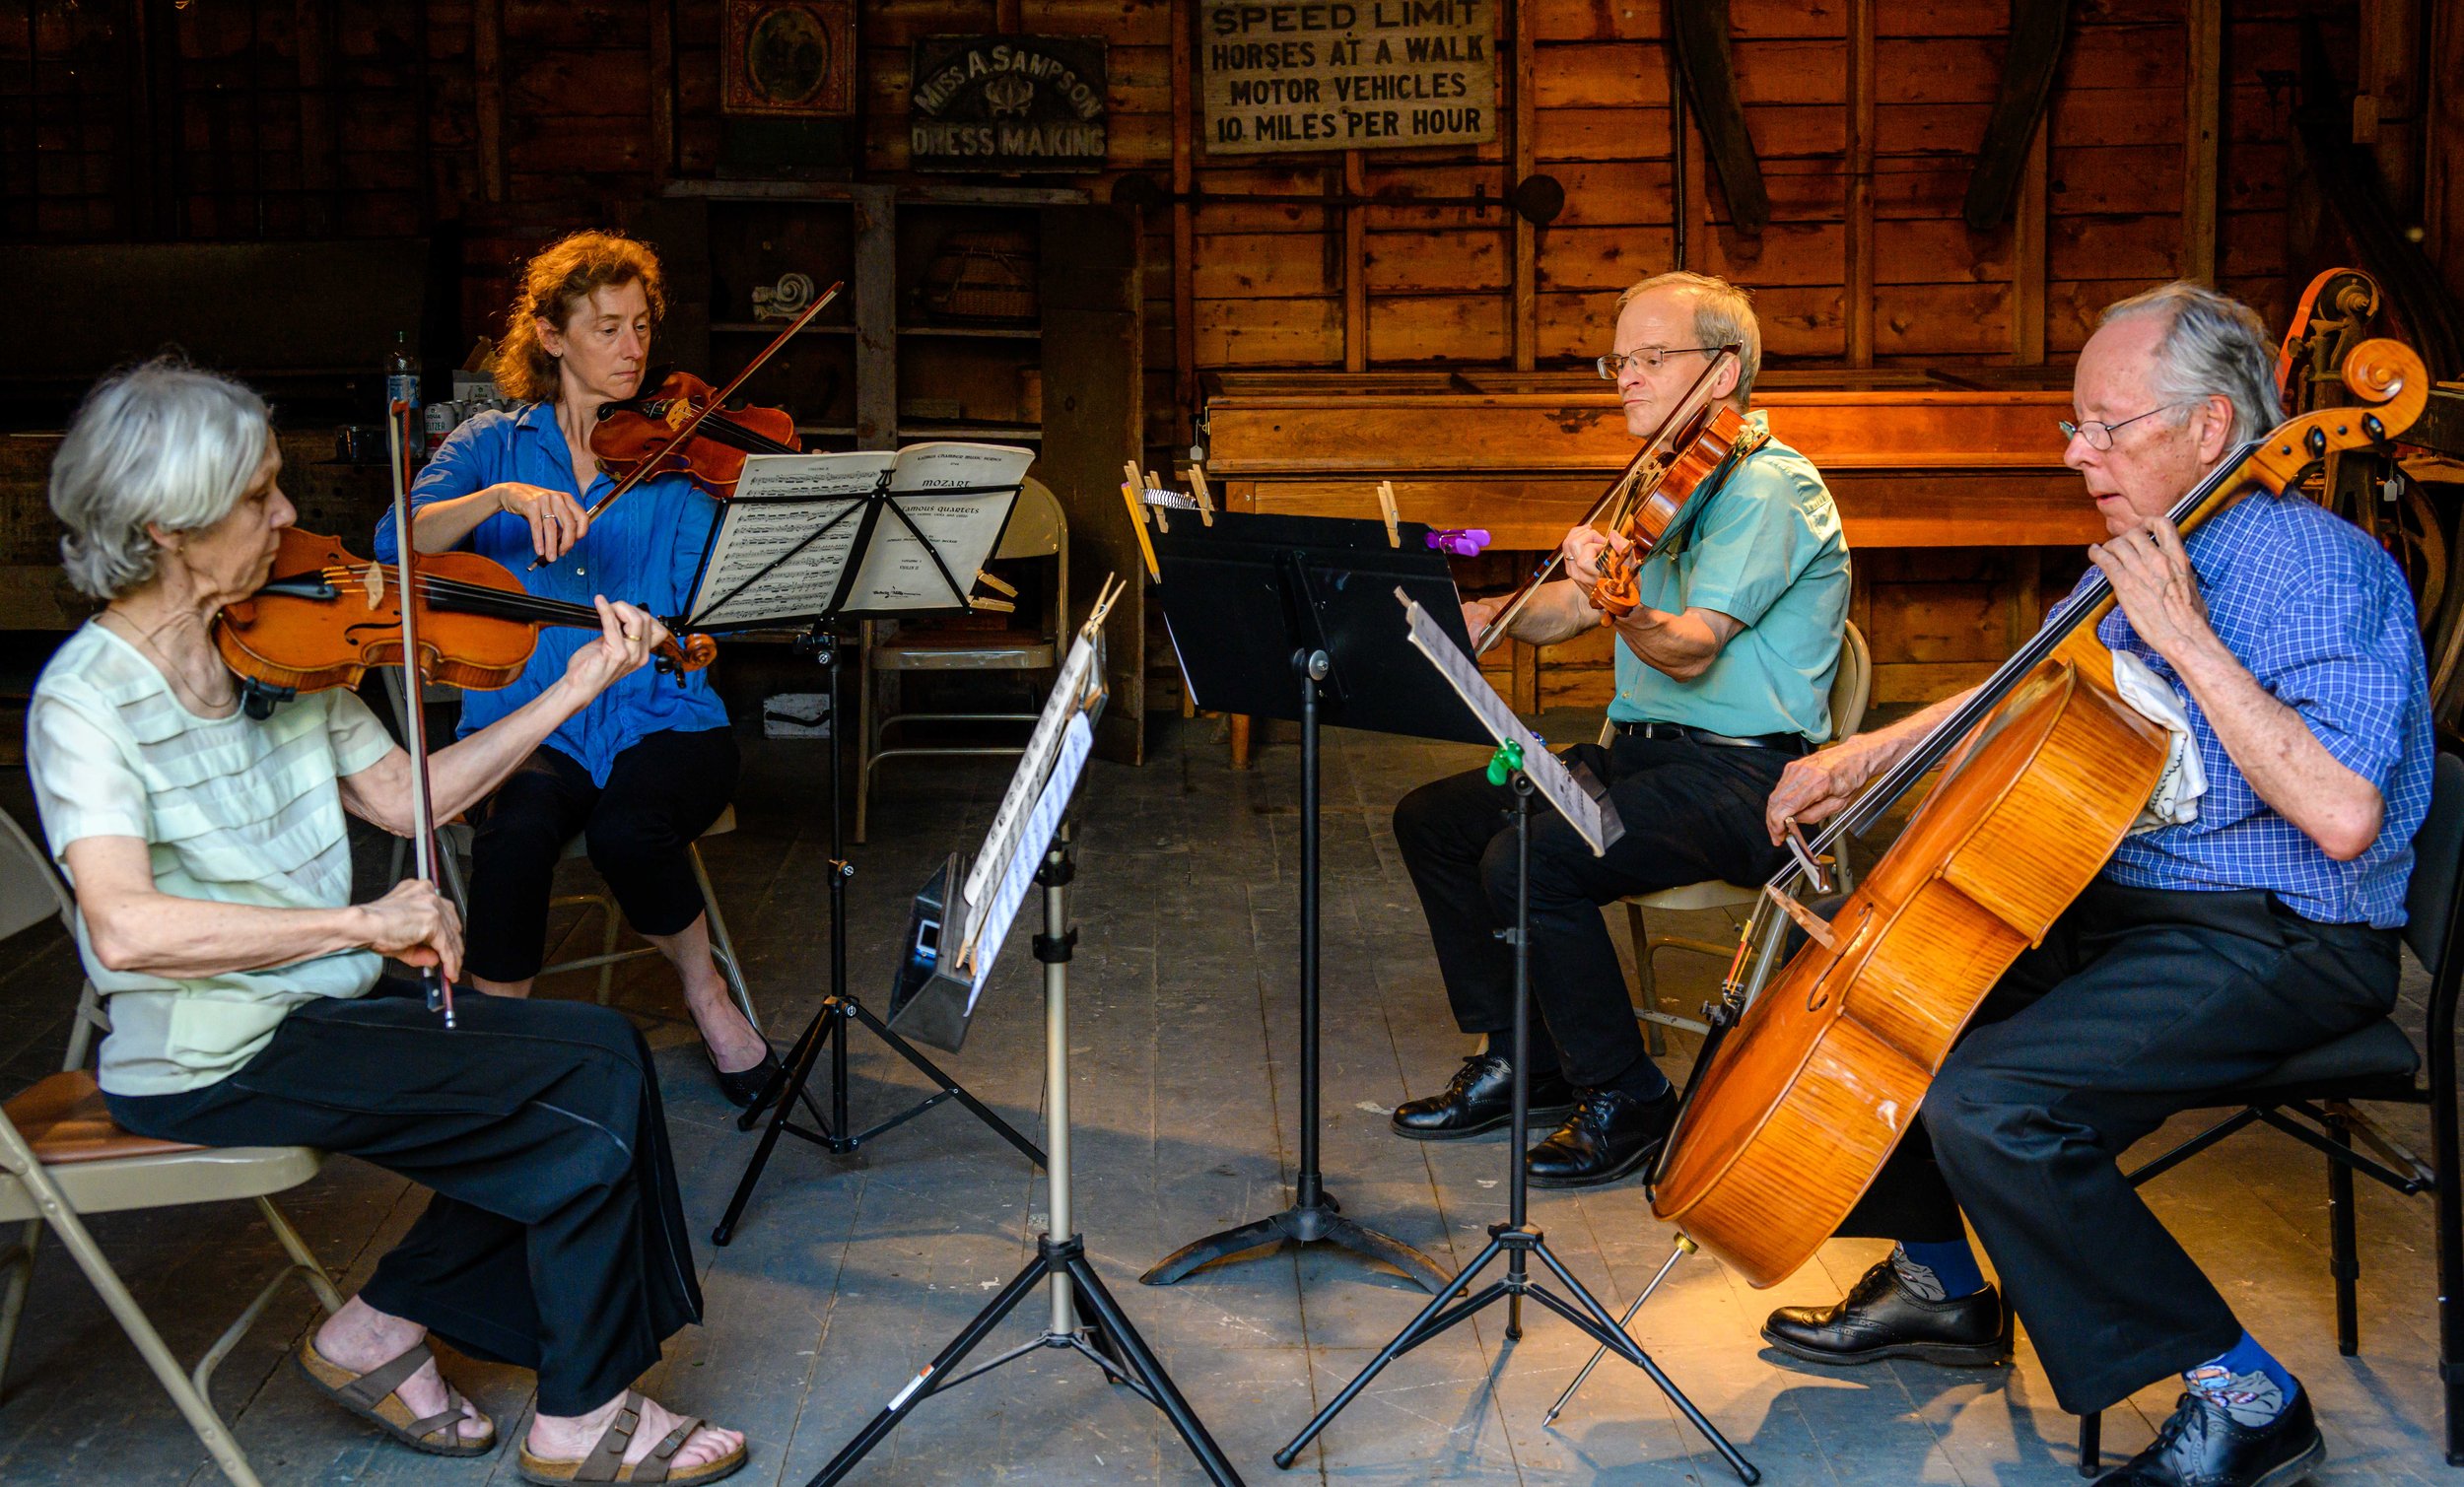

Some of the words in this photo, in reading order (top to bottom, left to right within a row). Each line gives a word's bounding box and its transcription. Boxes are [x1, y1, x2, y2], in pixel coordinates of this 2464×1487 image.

[1212, 6, 1356, 34] SPEED
[1375, 1, 1479, 29] LIMIT
[1212, 41, 1316, 70] HORSES
[1331, 40, 1361, 66] AT
[1375, 39, 1393, 64] A
[1405, 35, 1484, 63] WALK
[1231, 79, 1320, 106] MOTOR
[1335, 73, 1467, 101] VEHICLES
[1001, 125, 1105, 157] MAKING
[1256, 113, 1335, 141] MILES
[1348, 110, 1399, 137] PER
[1412, 108, 1480, 134] HOUR
